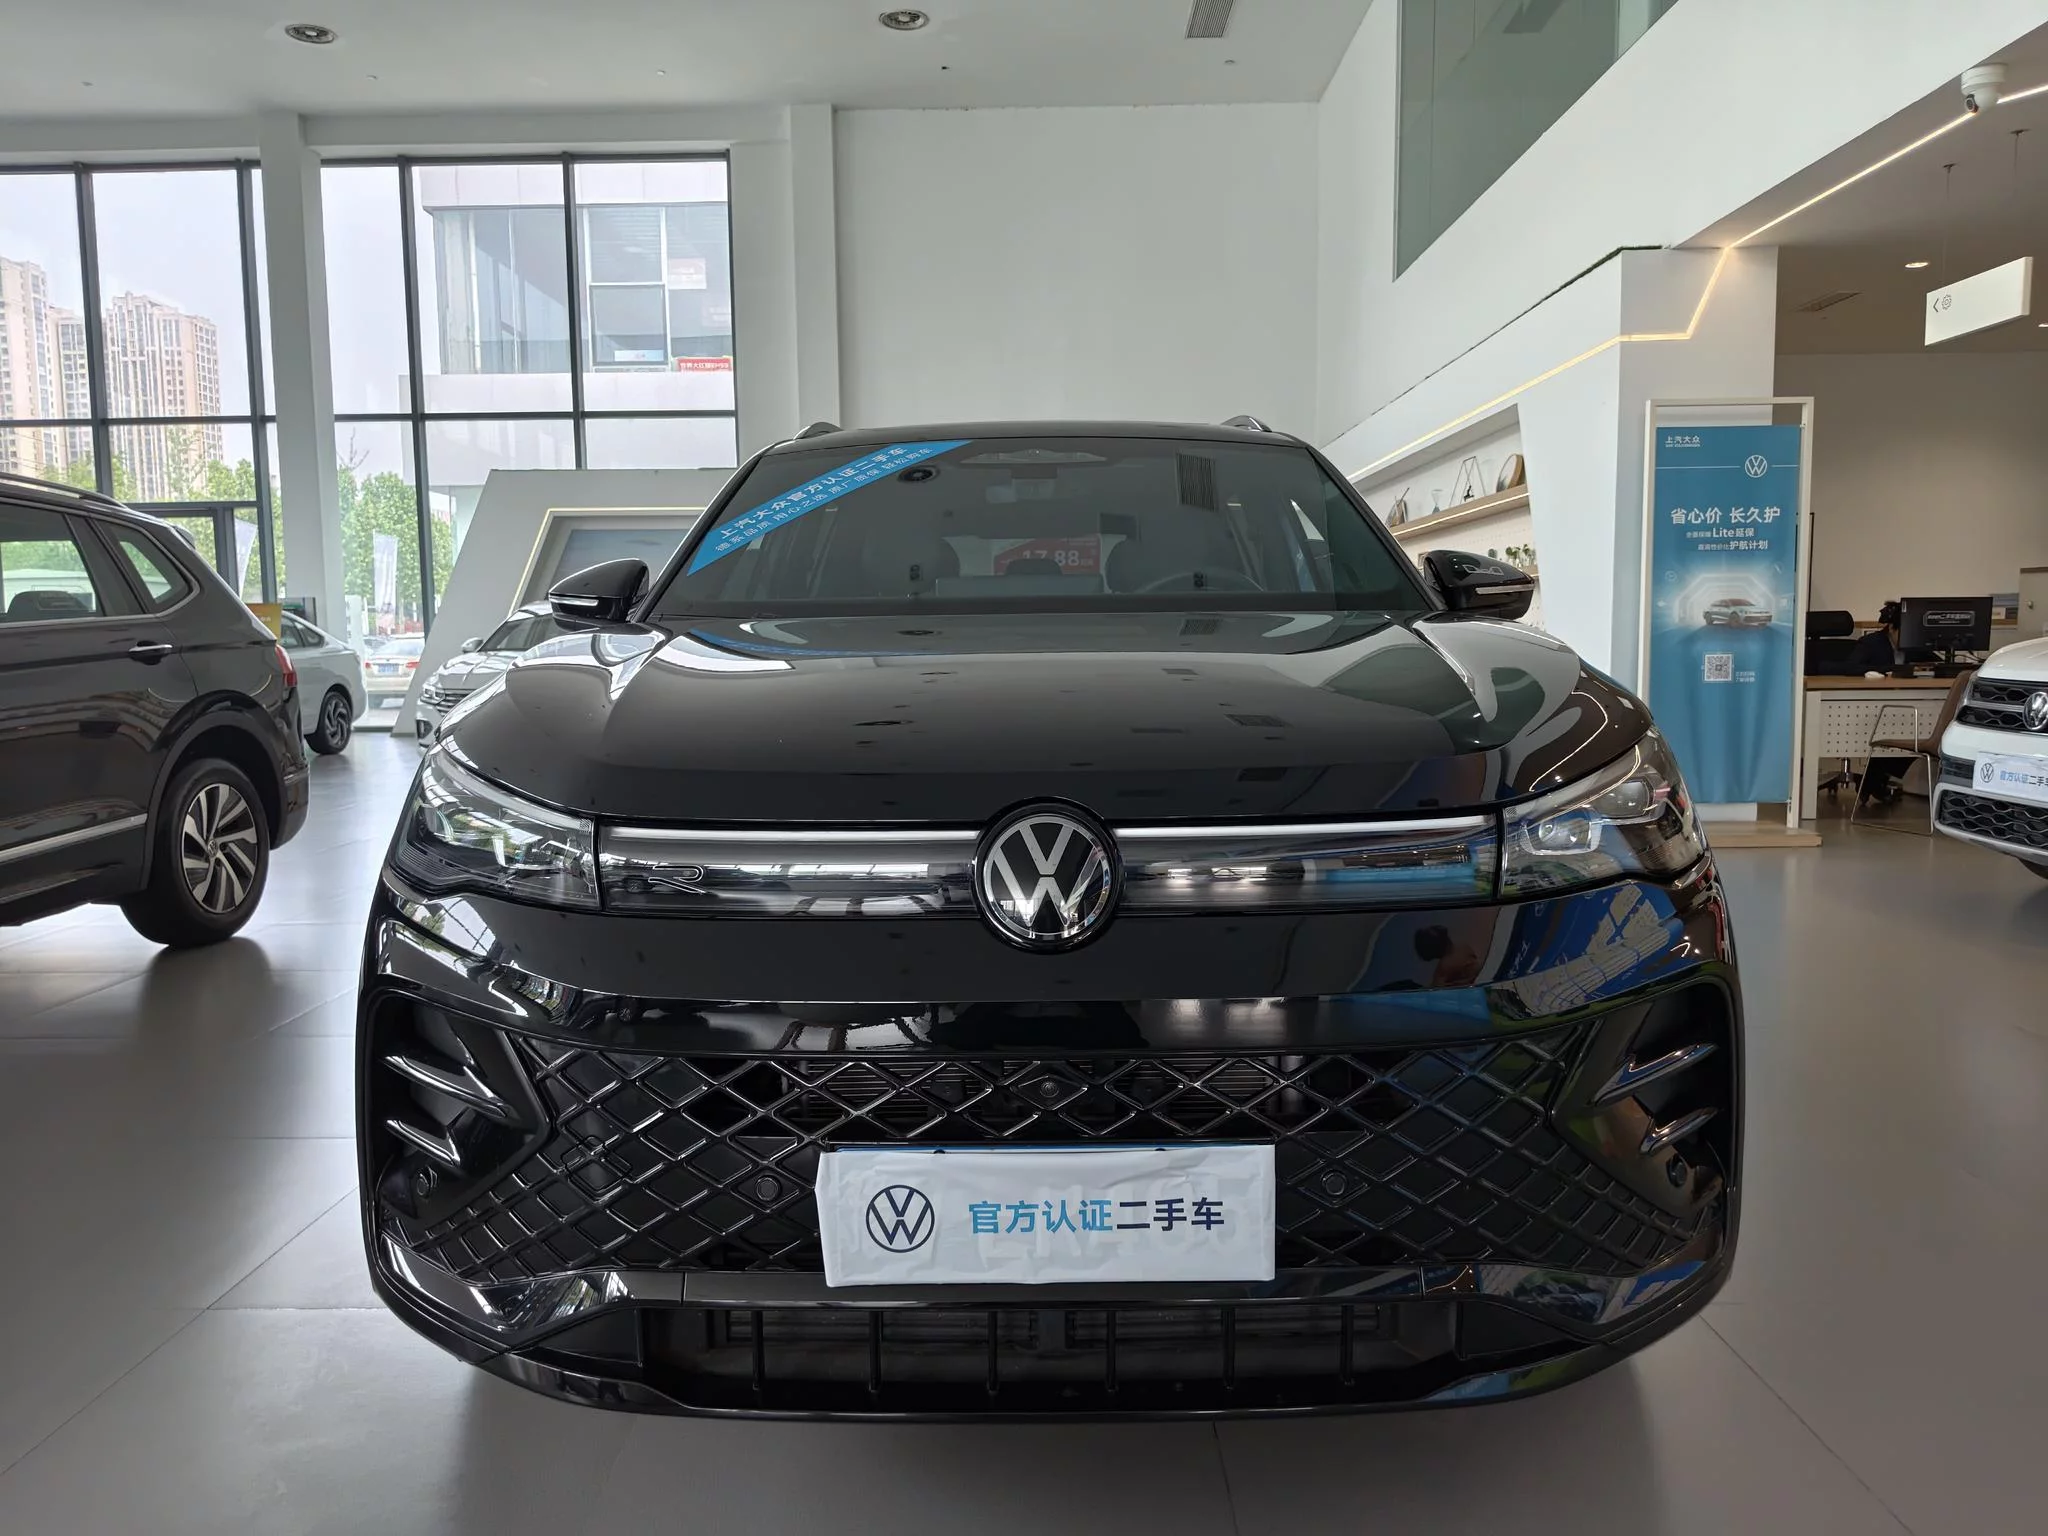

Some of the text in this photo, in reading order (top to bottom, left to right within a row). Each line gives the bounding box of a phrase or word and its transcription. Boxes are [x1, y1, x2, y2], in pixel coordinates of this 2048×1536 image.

[1665, 436, 1700, 444] 上汽大众
[720, 447, 908, 539] 上汽大众官方认证二手车
[1671, 506, 1781, 524] 省心价 长久护
[968, 1197, 1225, 1234] 官方认证二手车
